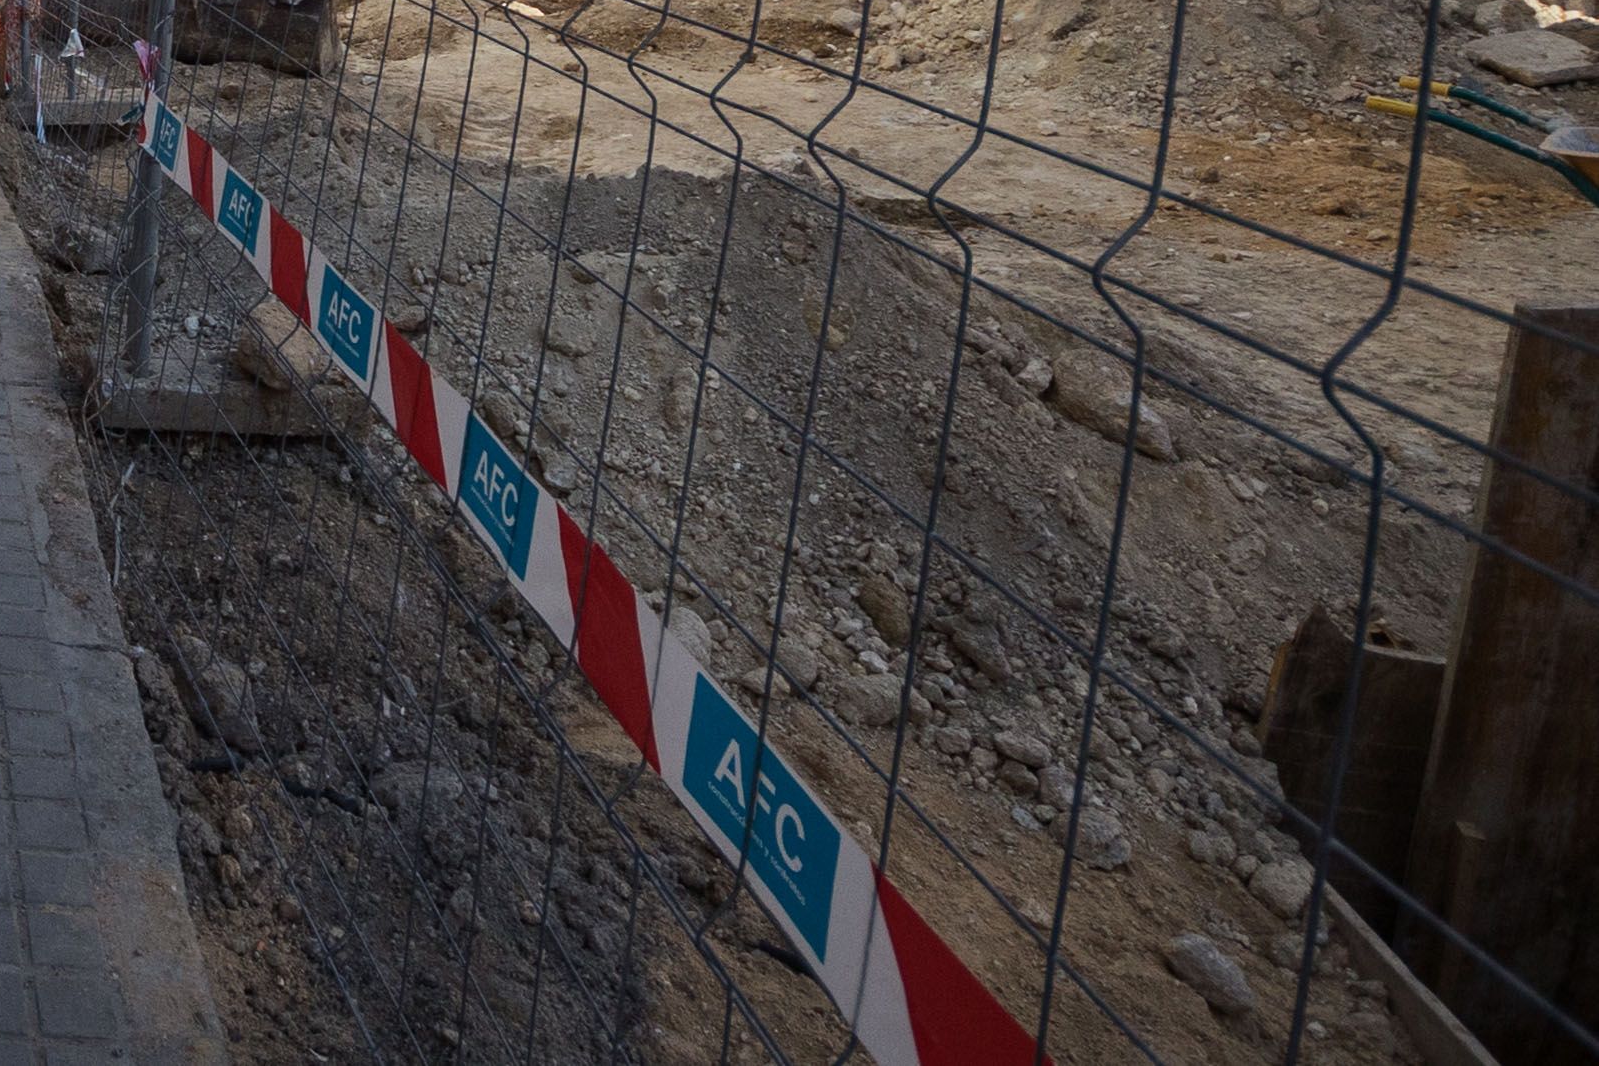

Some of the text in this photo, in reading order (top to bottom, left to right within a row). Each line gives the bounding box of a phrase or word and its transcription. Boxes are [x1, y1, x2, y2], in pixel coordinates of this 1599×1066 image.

[228, 188, 255, 229] AFC
[327, 290, 362, 344] AFC
[473, 449, 519, 528] AFC
[713, 738, 806, 873] AFC
